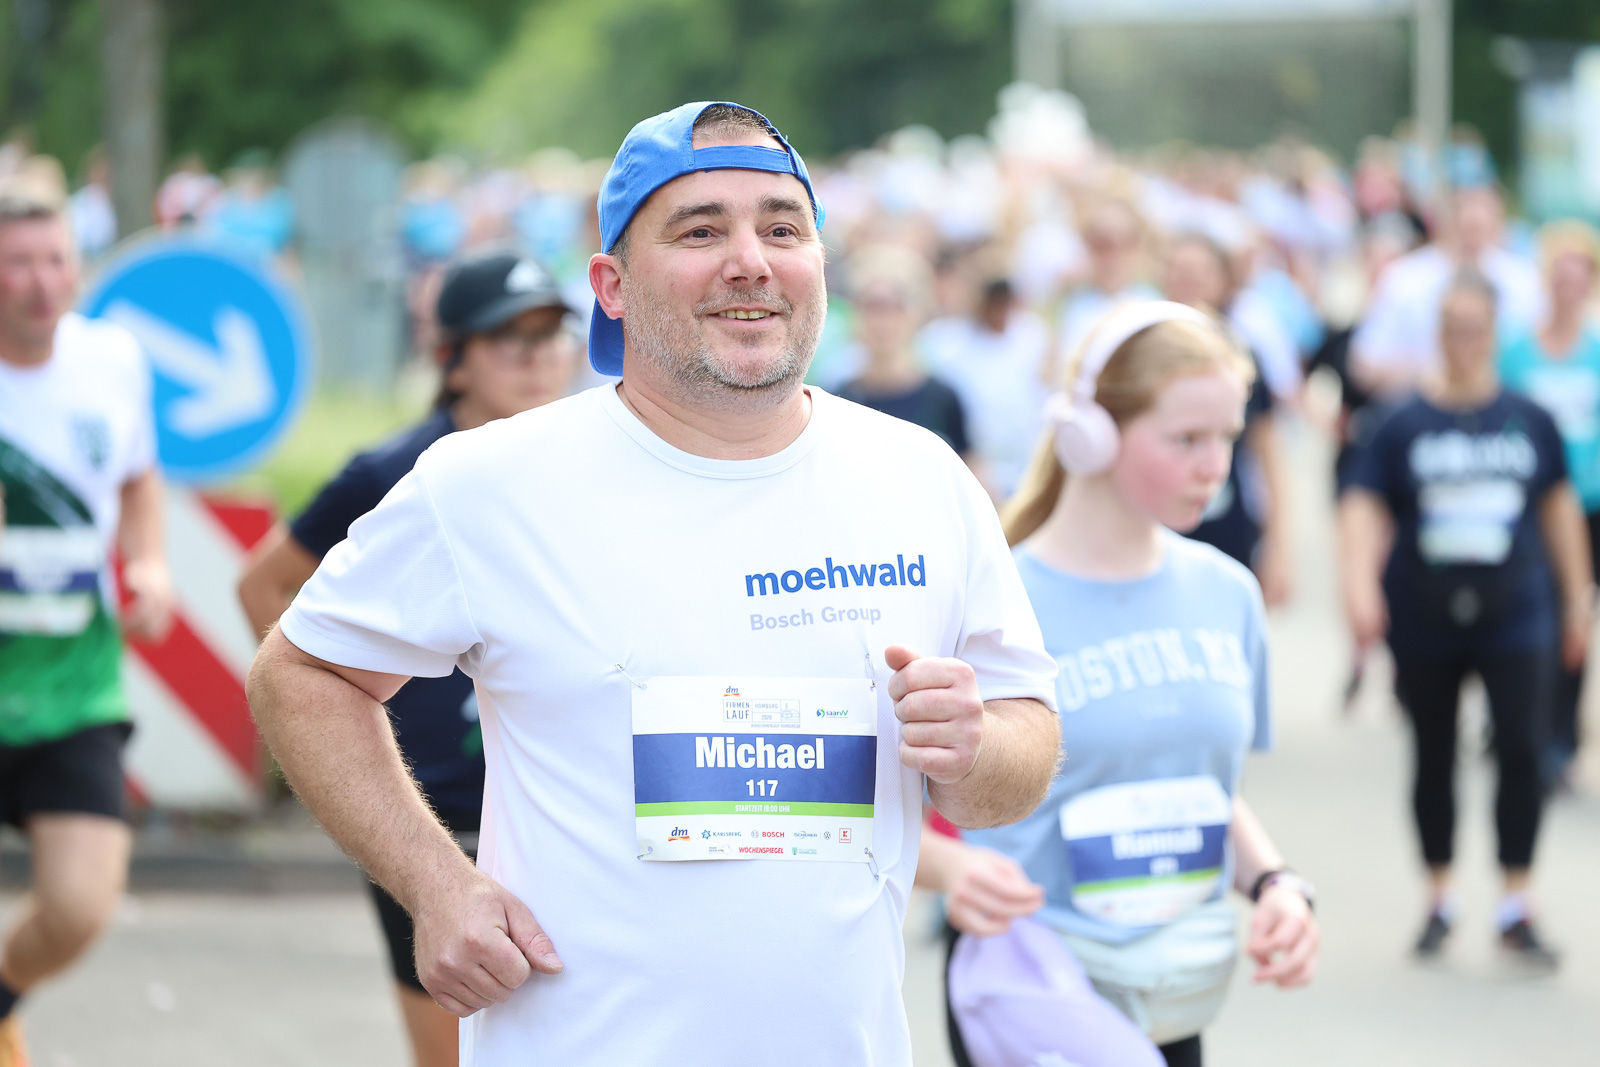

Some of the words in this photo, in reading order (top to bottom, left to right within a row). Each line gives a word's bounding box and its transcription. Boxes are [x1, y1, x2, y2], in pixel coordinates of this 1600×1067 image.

[745, 554, 926, 597] moehwald
[750, 608, 814, 630] Bosch
[821, 606, 881, 625] Group
[726, 709, 750, 719] LAUF
[695, 736, 825, 769] Michael
[745, 779, 778, 796] 117
[735, 804, 763, 812] STARTZEIT
[763, 804, 778, 812] 18:00
[671, 826, 688, 836] dm
